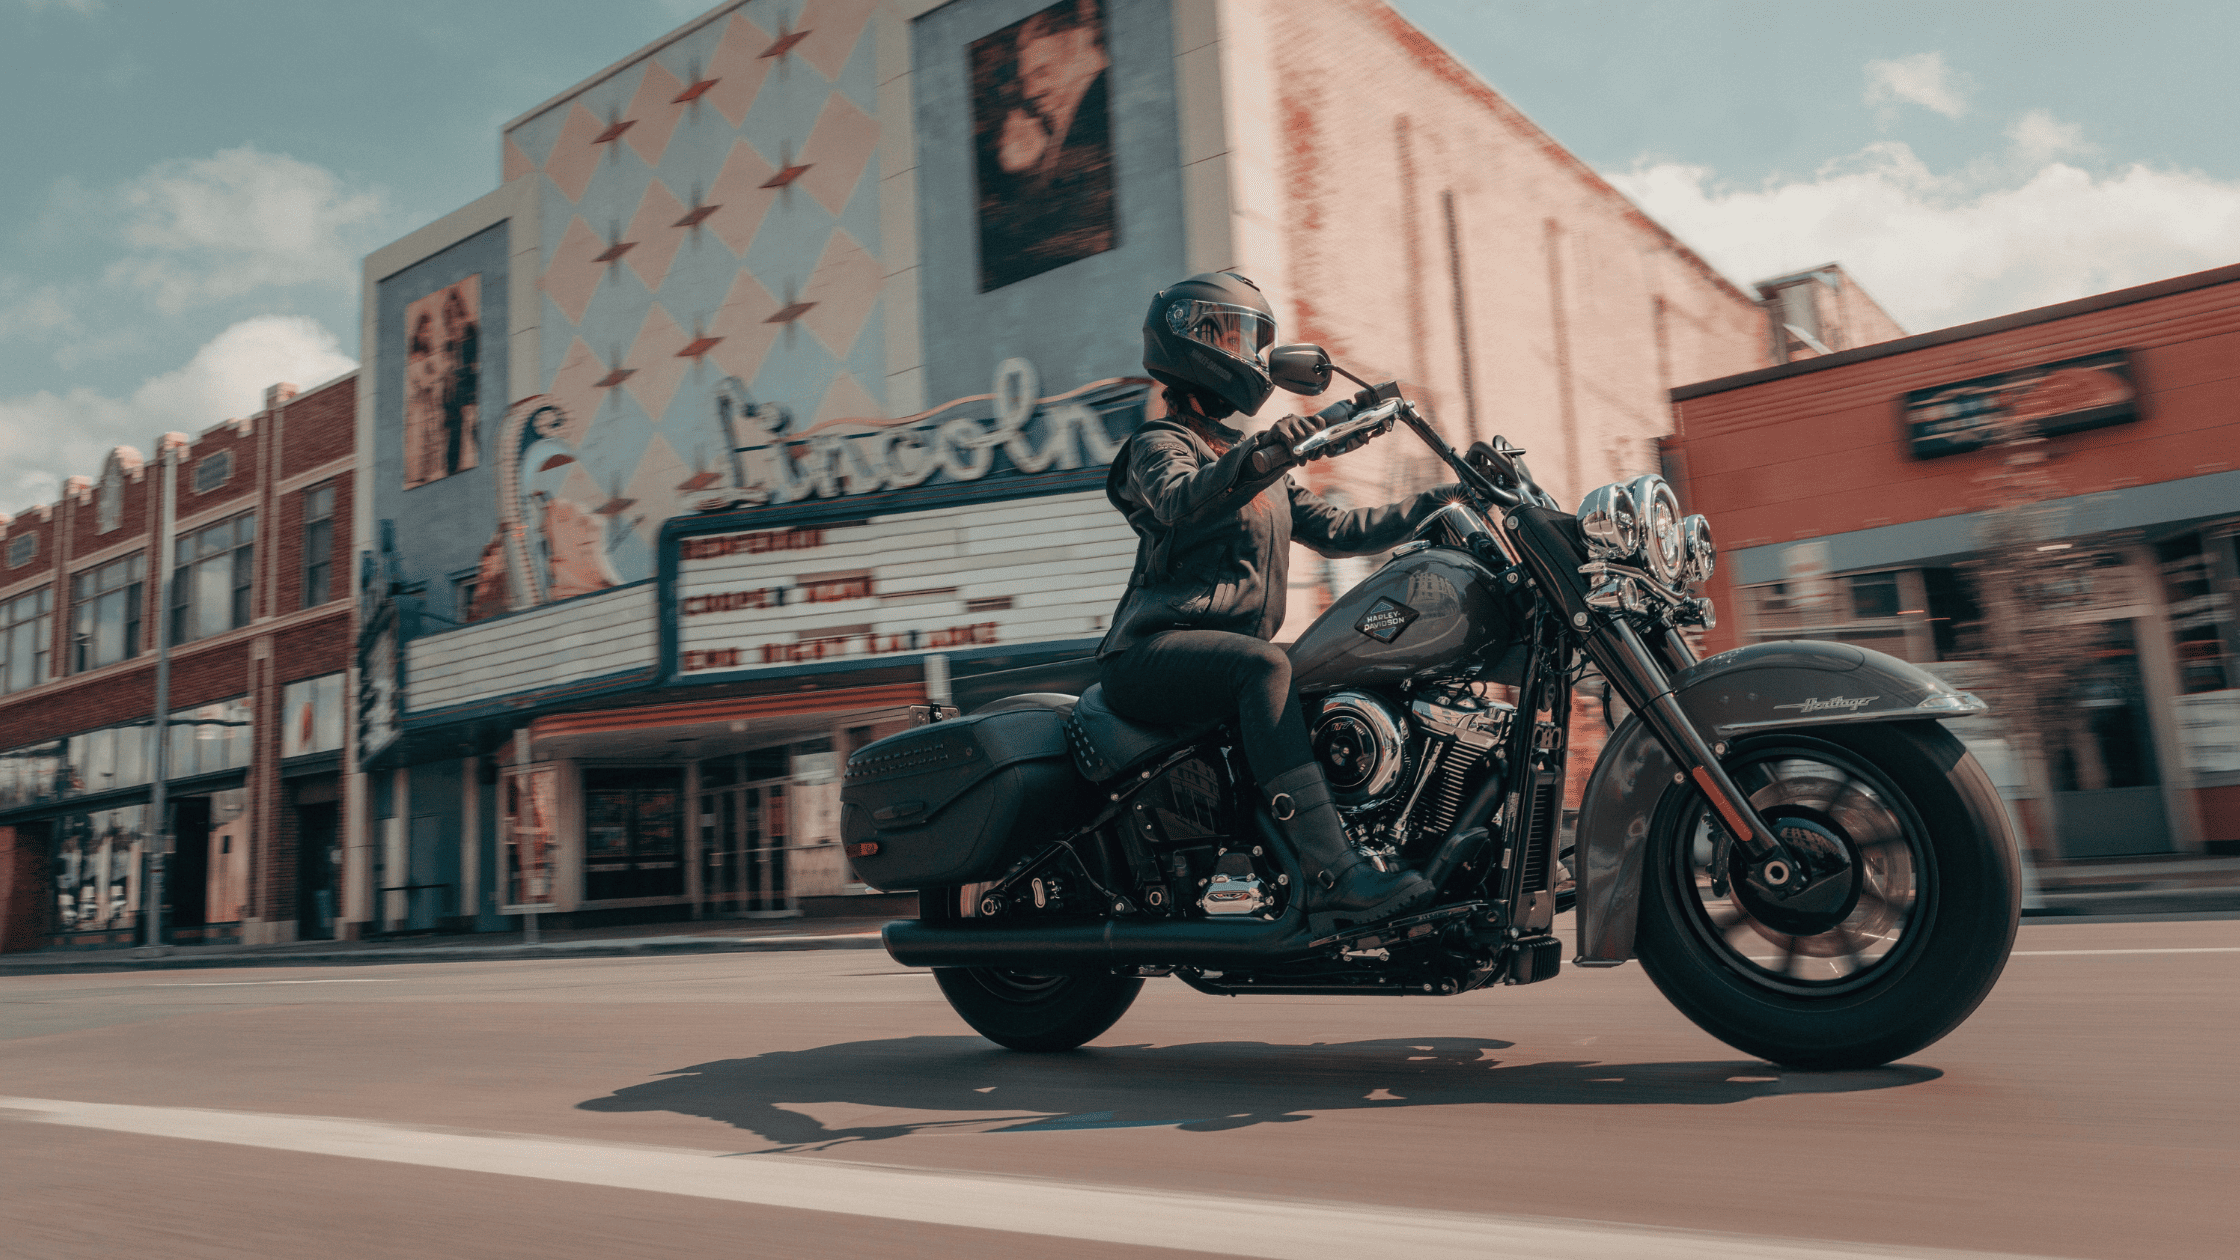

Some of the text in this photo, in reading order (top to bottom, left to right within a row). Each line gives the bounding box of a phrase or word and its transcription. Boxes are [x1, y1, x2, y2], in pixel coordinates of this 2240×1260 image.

[693, 356, 1122, 511] Lincoln
[1363, 616, 1405, 632] DAVIDSON
[1774, 695, 1880, 713] Heritage
